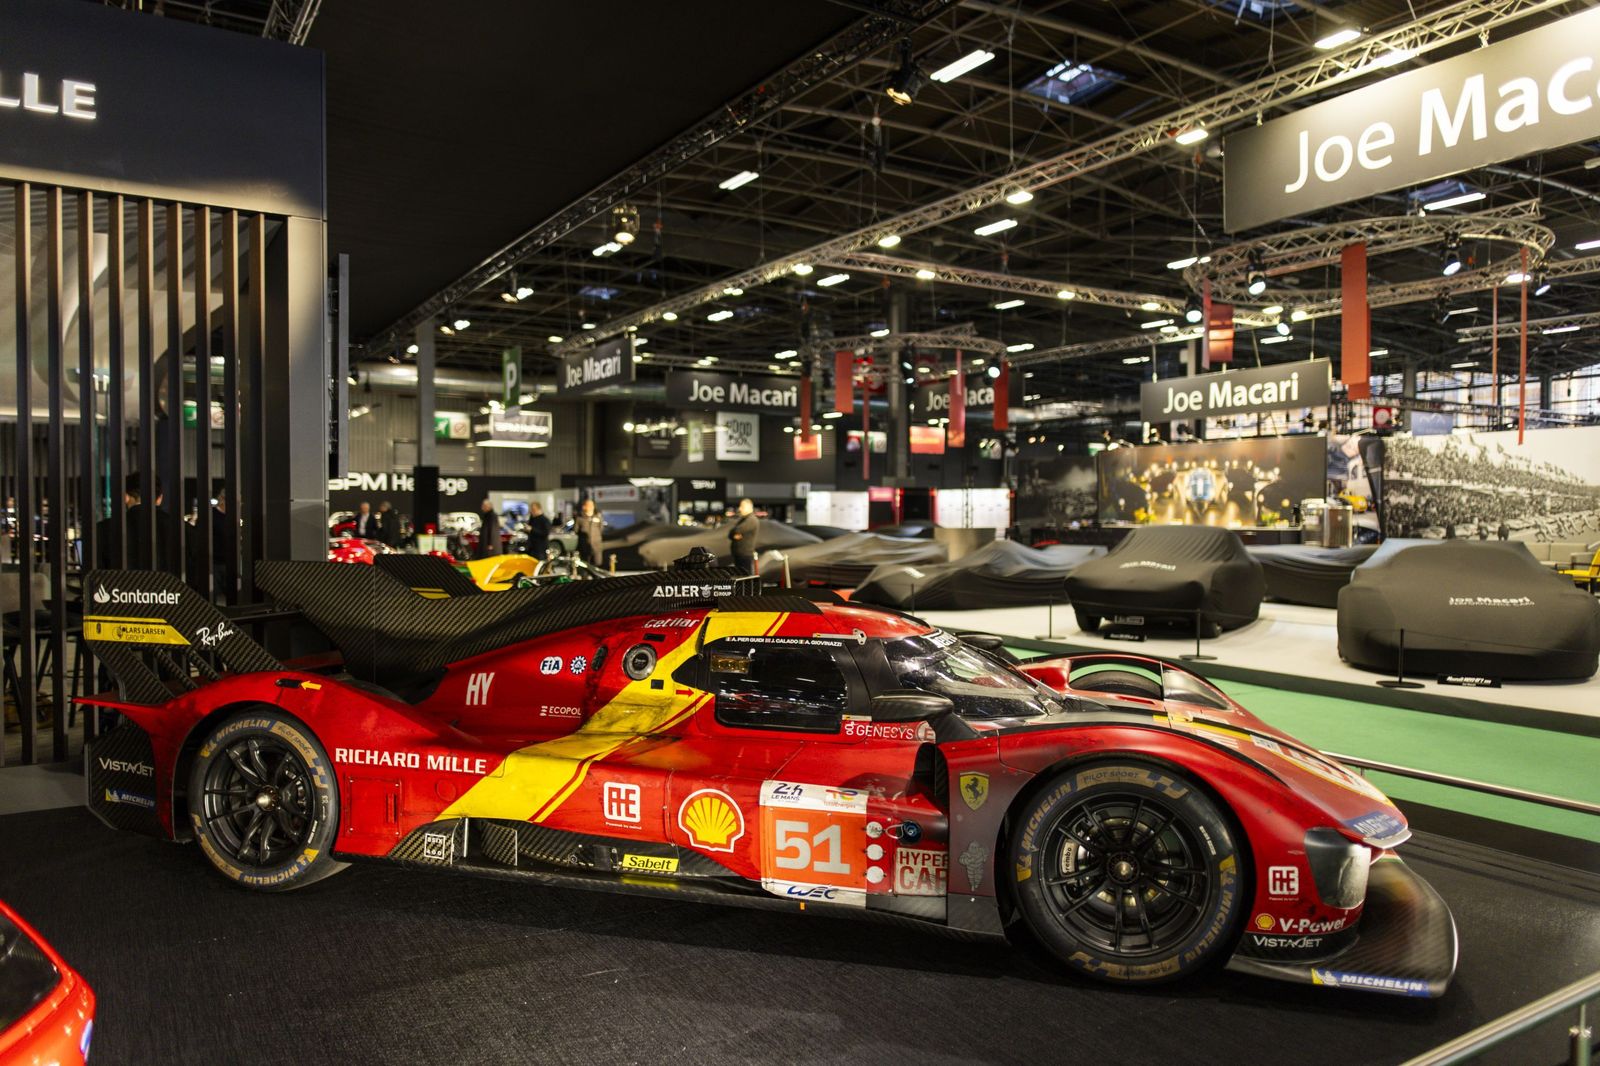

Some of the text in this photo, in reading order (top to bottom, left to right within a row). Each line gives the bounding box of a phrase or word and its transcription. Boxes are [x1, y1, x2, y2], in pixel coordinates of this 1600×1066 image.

[1284, 56, 1600, 193] Joe Mac
[565, 349, 621, 388] Joe Macari
[688, 379, 797, 407] Joe Macari
[926, 390, 949, 412] Joe
[1163, 372, 1299, 414] Joe Macari
[112, 588, 181, 605] Santander
[652, 585, 700, 598] ADLER
[125, 626, 166, 636] LARS LARSEN
[196, 622, 234, 646] Ray-Ban
[465, 672, 495, 705] HY
[548, 706, 582, 716] ECOPOL
[216, 719, 271, 740] MICHELIN
[856, 724, 914, 740] GENESYS
[335, 747, 487, 775] RICHARD MILLE
[1083, 769, 1139, 782] PILOT SPORT
[121, 793, 155, 807] MICHELIN
[1022, 782, 1072, 850] MICHELIN
[775, 819, 850, 875] 51
[628, 856, 672, 870] Sabelt
[244, 864, 300, 884] MICHELIN
[1183, 890, 1233, 962] MICHELIN
[1279, 916, 1347, 933] V-Power
[1341, 974, 1424, 992] MICHELIN
